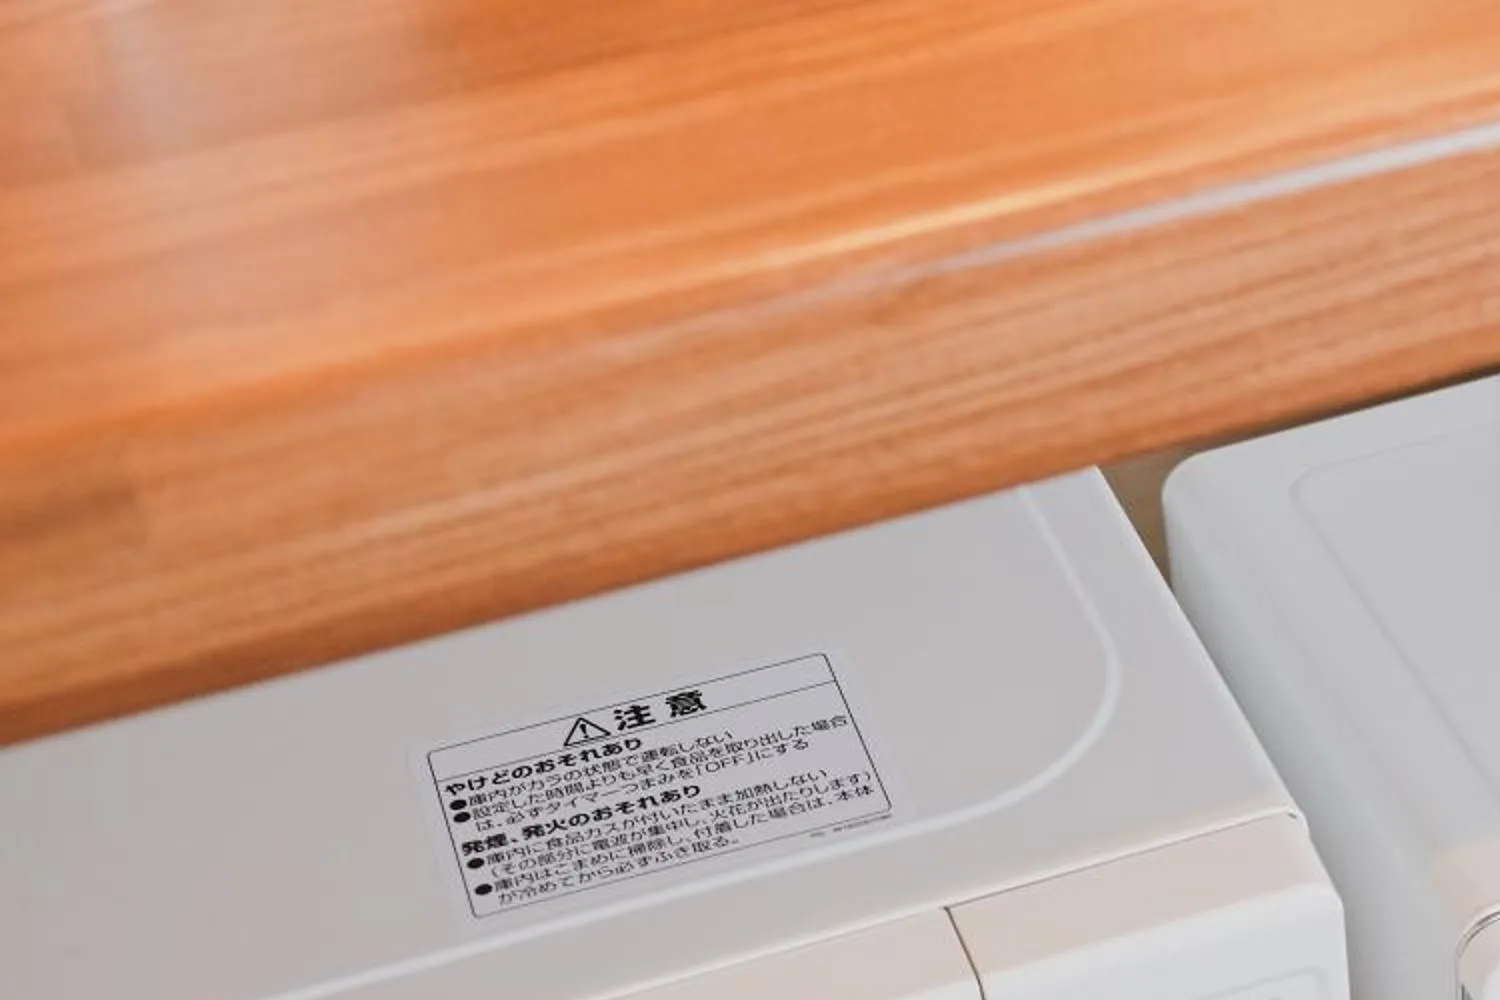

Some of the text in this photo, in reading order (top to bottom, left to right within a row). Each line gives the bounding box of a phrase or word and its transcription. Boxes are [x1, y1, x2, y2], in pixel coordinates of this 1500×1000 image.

[610, 687, 708, 732] 注意
[443, 735, 644, 797] やけどのおそれあり
[460, 782, 703, 856] 発煙、発火のおそれあり
